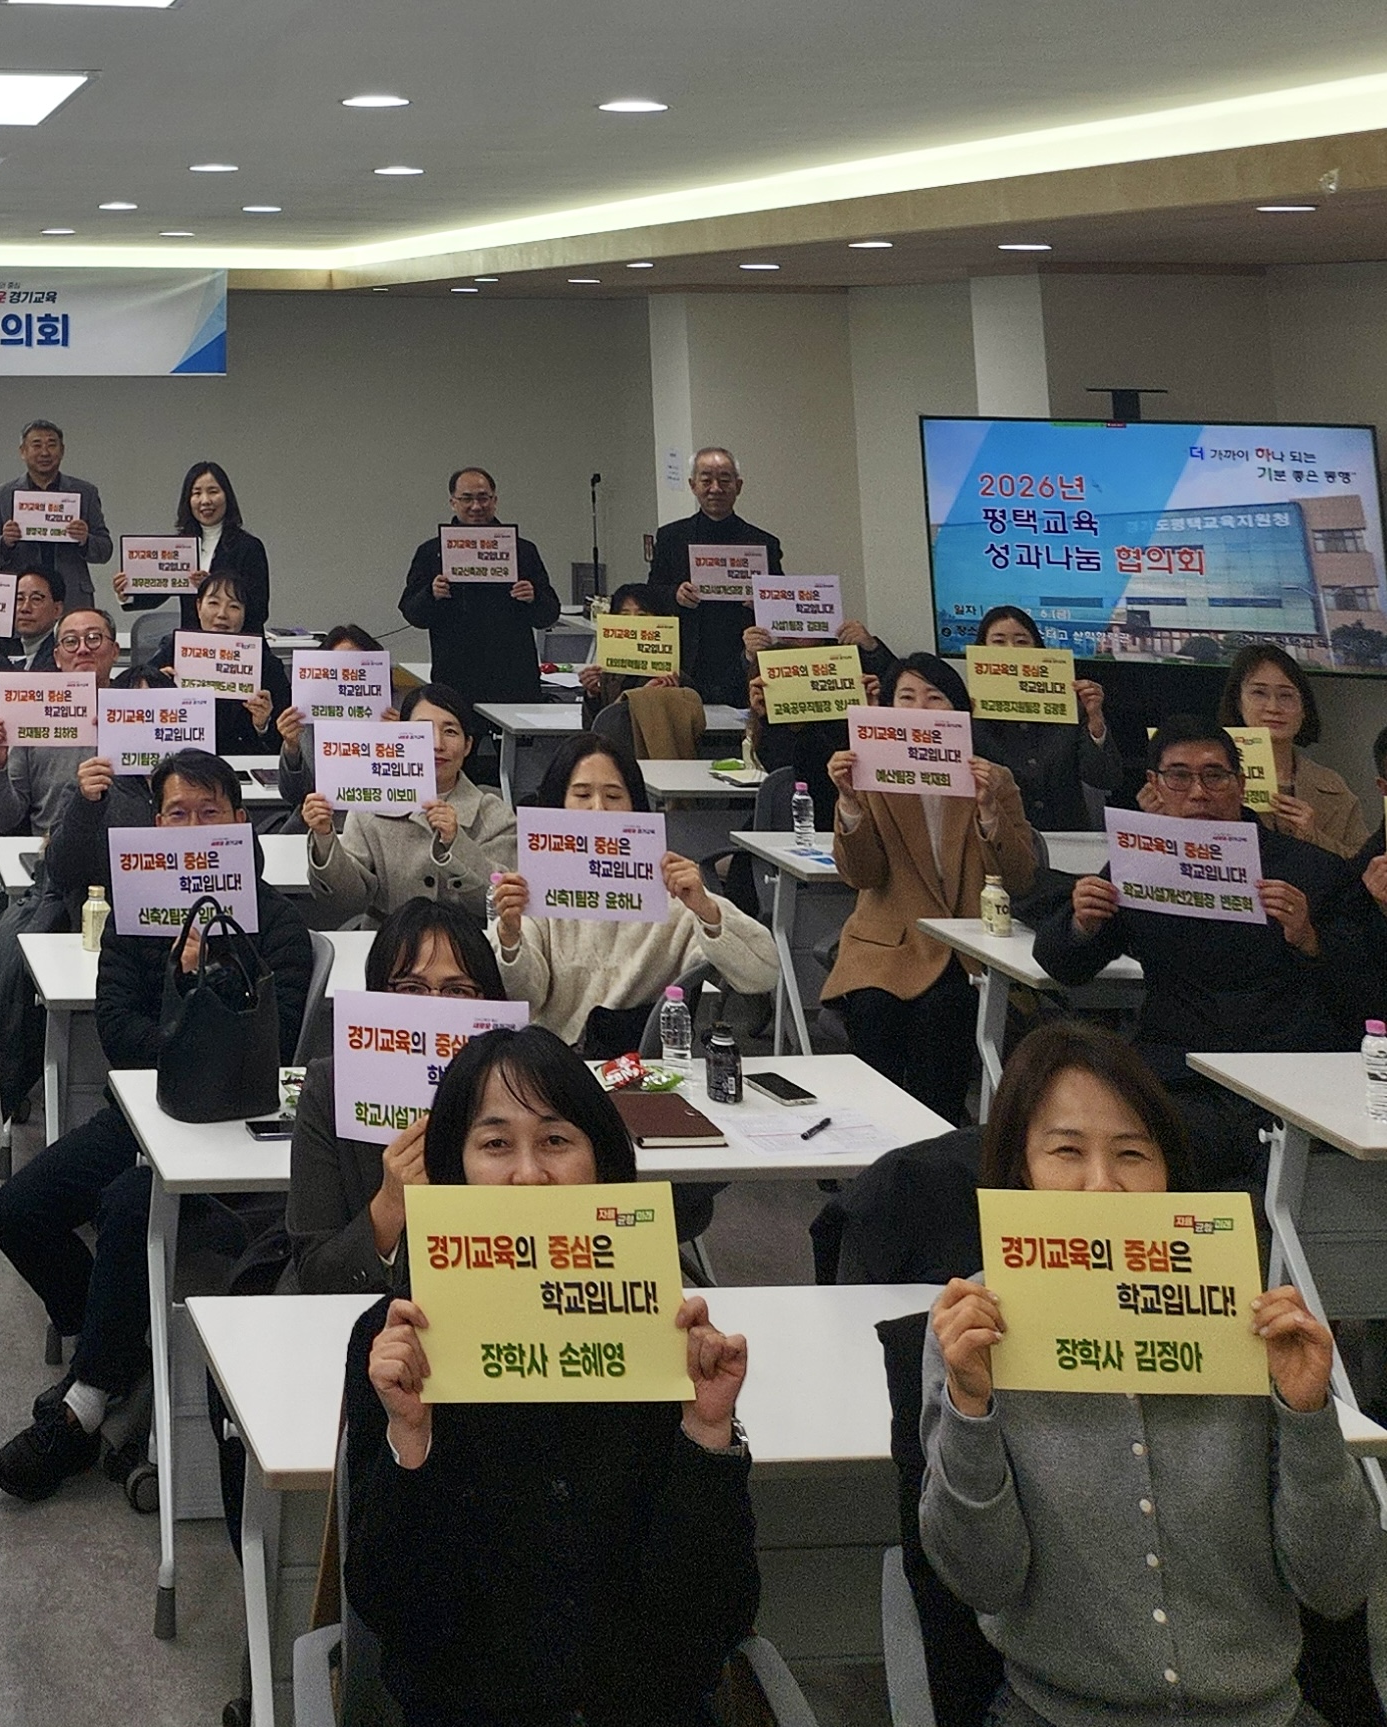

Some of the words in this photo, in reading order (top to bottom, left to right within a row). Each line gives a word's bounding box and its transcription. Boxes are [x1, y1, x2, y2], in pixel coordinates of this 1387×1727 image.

[9, 291, 57, 303] 경기교육
[1190, 447, 1204, 460] 더
[1210, 450, 1249, 461] 가까이
[1255, 448, 1284, 462] 하나
[1290, 451, 1316, 464] 되는
[1258, 467, 1286, 482] 기분
[1292, 470, 1319, 483] 좋은
[978, 473, 1086, 502] 2026년
[982, 507, 1099, 538] 평택교육
[1127, 512, 1290, 534] 경기도평택교육지원청
[984, 542, 1102, 573] 성과나눔
[1115, 545, 1207, 577] 협의회
[299, 668, 337, 680] 경기교육의
[342, 669, 366, 681] 중심은
[767, 665, 809, 679] 경기교육의
[812, 663, 837, 676] 중심은
[338, 685, 381, 696] 학교입니다!
[810, 678, 855, 691] 학교입니다!
[5, 690, 43, 702] 경기교육의
[48, 690, 72, 702] 중심은
[45, 706, 87, 717] 학교입니다!
[107, 709, 154, 723] 경기교육의
[160, 709, 187, 723] 중심은
[155, 728, 204, 742] 학교입니다!
[857, 726, 907, 742] 경기교육의
[912, 729, 942, 744] 중심은
[323, 742, 370, 757] 경기교육의
[376, 743, 405, 758] 중심은
[908, 747, 961, 763] 학교입니다!
[371, 762, 423, 777] 학교입니다!
[876, 769, 916, 784] 예산팀장
[336, 787, 382, 801] 시설3팀장
[387, 788, 416, 802] 이보미
[528, 833, 588, 853] 경기교육의
[595, 837, 631, 856] 중심은
[1117, 832, 1178, 856] 경기교육의
[1185, 841, 1223, 861] 중심은
[120, 853, 178, 871] 경기교육의
[184, 851, 219, 870] 중심은
[589, 860, 653, 880] 학교입니다!
[1180, 862, 1247, 883] 학교입니다!
[179, 874, 242, 893] 학교입니다!
[545, 889, 599, 908] 신축1팀장
[606, 892, 642, 910] 윤하나
[138, 907, 189, 926] 신축2팀장
[348, 1026, 426, 1055] 경기교육의
[435, 1031, 470, 1058] 중심
[596, 1207, 617, 1223] 자율
[616, 1212, 636, 1227] 균형
[634, 1208, 654, 1223] 미래
[1174, 1215, 1194, 1230] 자율
[1193, 1220, 1213, 1235] 균형
[1212, 1217, 1234, 1231] 미래
[427, 1236, 537, 1269] 경기교육의
[549, 1235, 614, 1269] 중심은
[1002, 1237, 1113, 1271] 경기교육의
[1125, 1240, 1192, 1273] 중심은
[540, 1281, 658, 1315] 학교입니다!
[1117, 1283, 1236, 1316] 학교입니다!
[481, 1343, 548, 1378] 장학사
[559, 1342, 625, 1377] 손혜영
[1056, 1339, 1123, 1371] 장학사
[1135, 1341, 1203, 1373] 김정아
